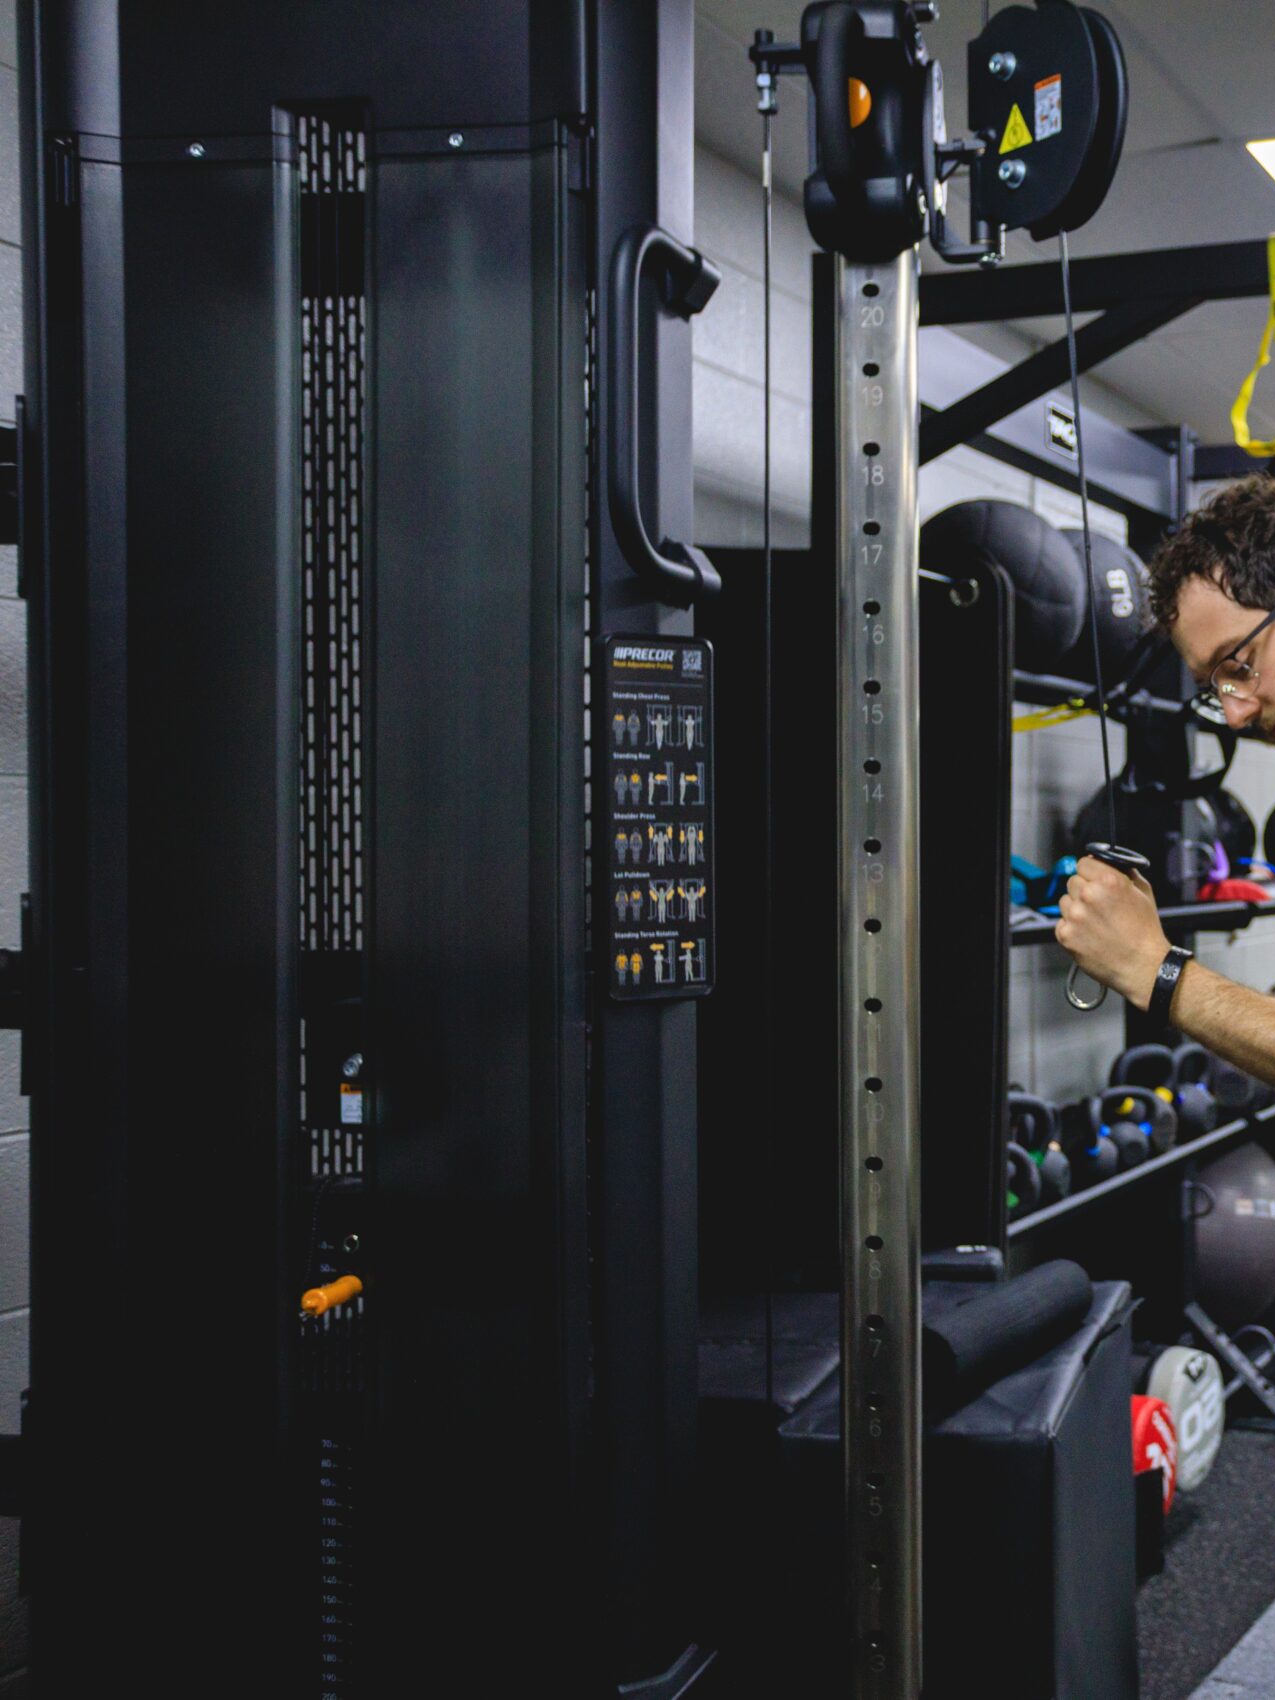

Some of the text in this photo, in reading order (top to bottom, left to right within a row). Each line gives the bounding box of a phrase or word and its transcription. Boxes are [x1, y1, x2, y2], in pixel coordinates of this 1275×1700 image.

[860, 306, 885, 328] 20
[861, 386, 883, 406] 19
[862, 465, 884, 486] 18
[861, 545, 884, 566] 17
[862, 624, 885, 645] 16
[621, 647, 674, 662] PRECOR
[612, 692, 670, 701] Standing Chest Press
[862, 704, 884, 724] 15
[613, 752, 637, 761] Standing
[862, 783, 885, 803] 14
[613, 812, 639, 820] Shoulder
[862, 863, 885, 883] 13
[614, 931, 639, 940] Standing
[640, 930, 656, 938] Torso
[867, 1259, 882, 1280] 8
[872, 1338, 883, 1358] 7
[869, 1417, 882, 1439] 6
[868, 1496, 884, 1517] 5
[870, 1654, 886, 1673] 3
